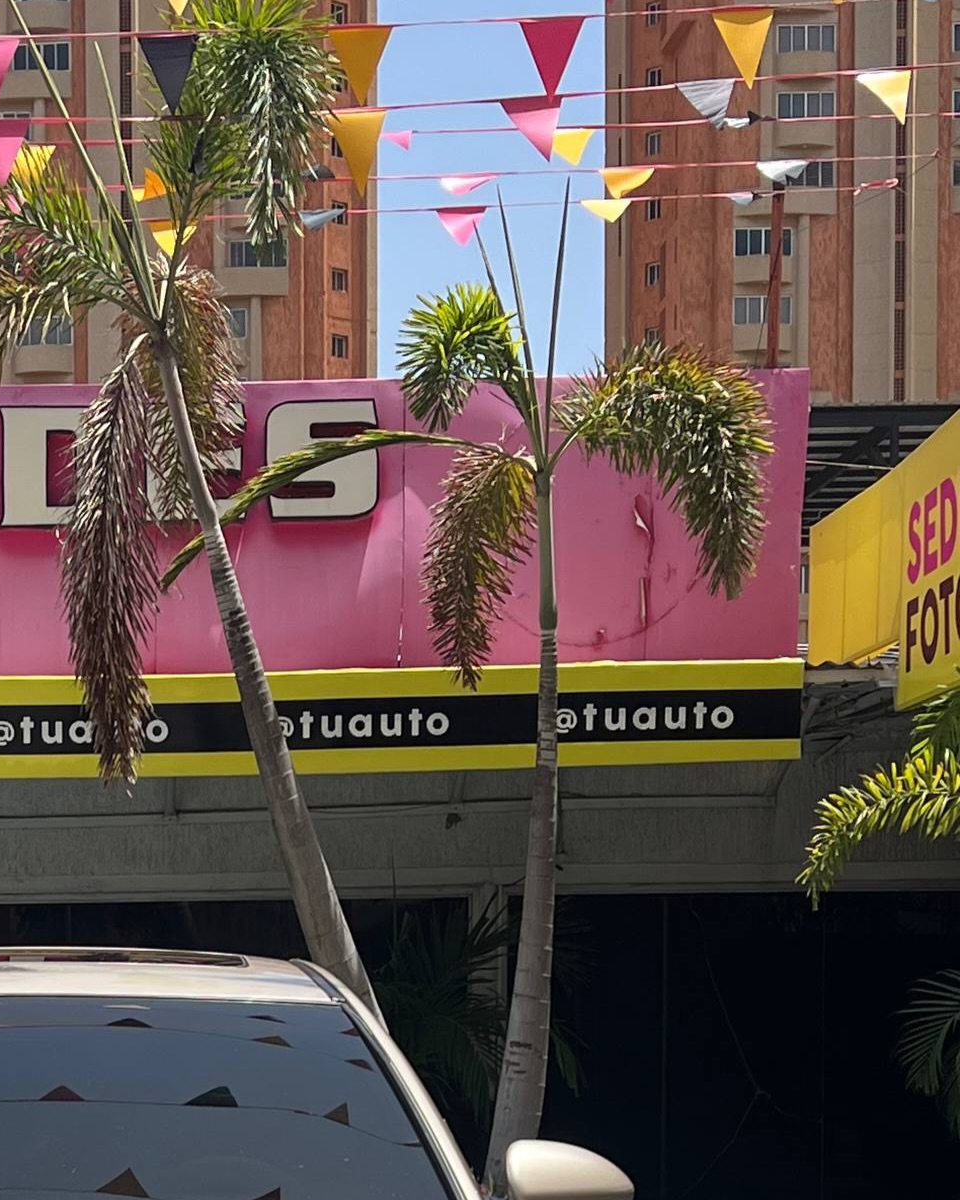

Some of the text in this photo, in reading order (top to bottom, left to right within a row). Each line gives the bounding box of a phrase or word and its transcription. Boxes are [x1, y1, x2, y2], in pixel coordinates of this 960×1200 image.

[907, 477, 958, 584] SED
[905, 575, 960, 673] FOT
[556, 702, 735, 734] @tuauto
